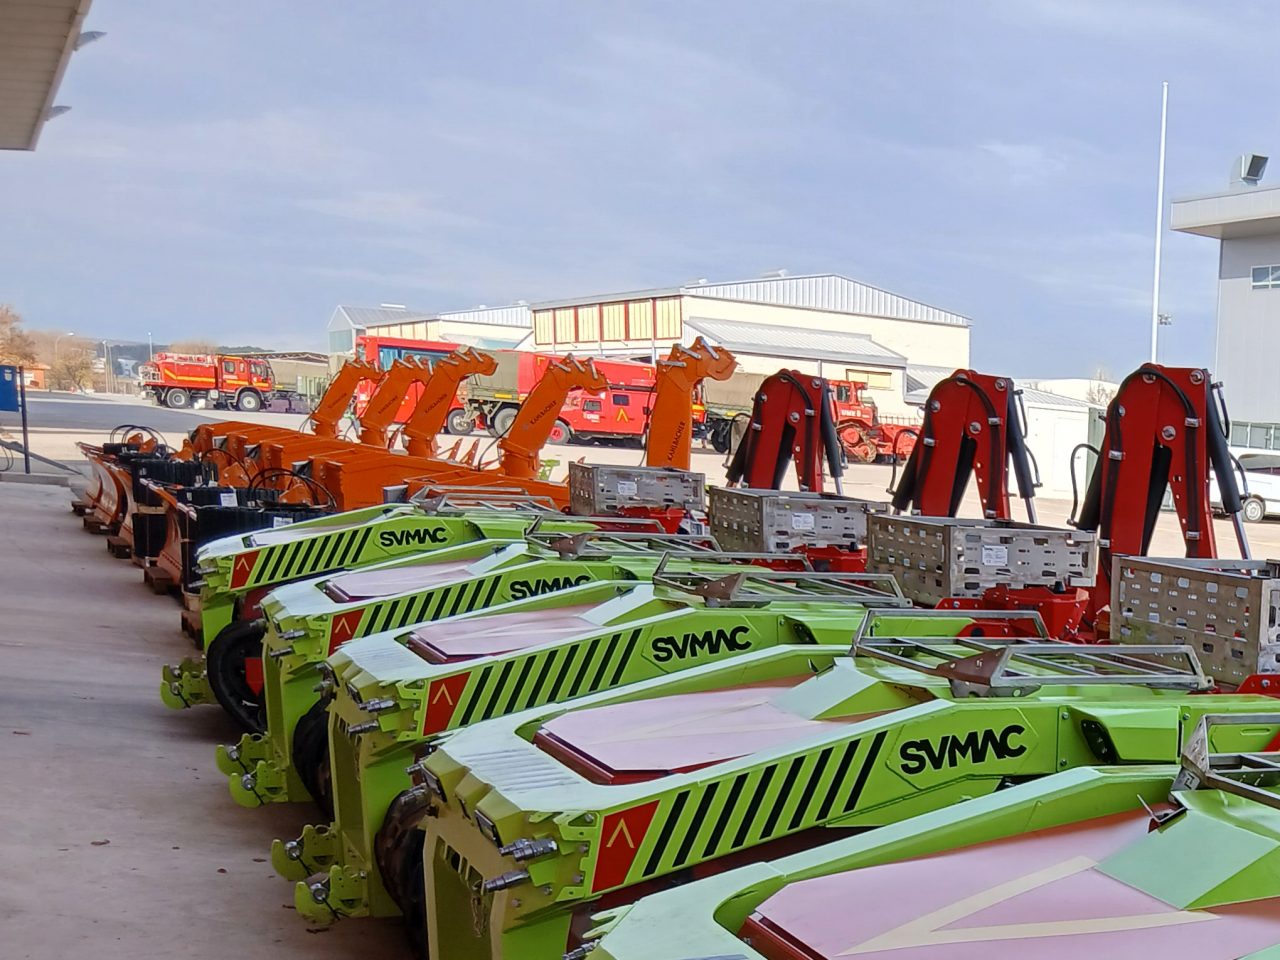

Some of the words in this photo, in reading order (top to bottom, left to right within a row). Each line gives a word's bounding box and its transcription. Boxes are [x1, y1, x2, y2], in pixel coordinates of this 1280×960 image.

[667, 421, 686, 462] KAHLBACHER
[379, 527, 448, 548] SVMAC
[652, 626, 752, 663] SVMAC
[900, 724, 1027, 775] SVMAC
